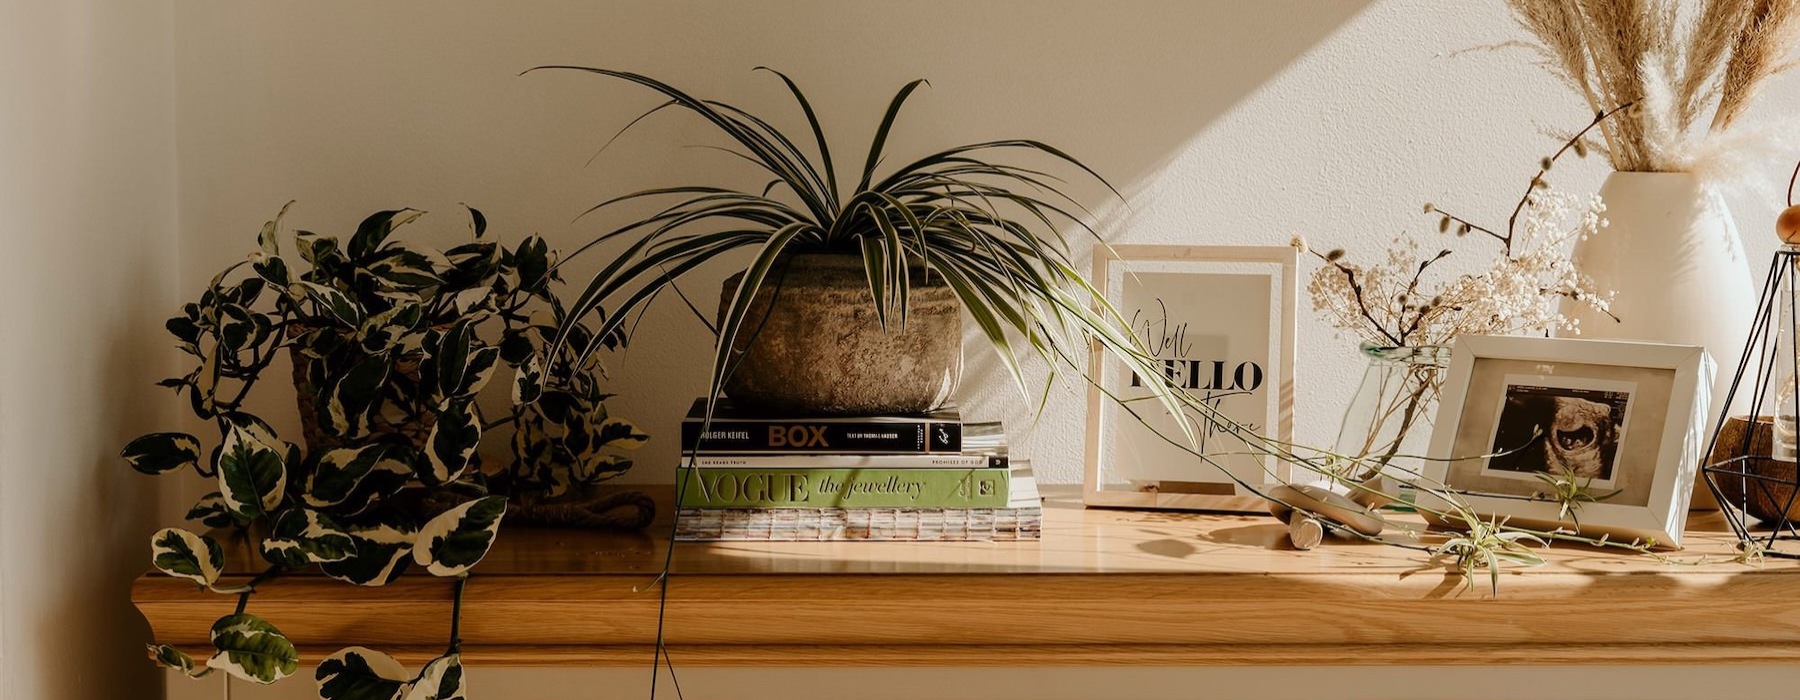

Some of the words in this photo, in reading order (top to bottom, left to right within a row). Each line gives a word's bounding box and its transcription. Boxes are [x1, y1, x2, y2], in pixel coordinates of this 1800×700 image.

[1131, 359, 1263, 391] ELLO
[727, 431, 750, 440] KEIFEL
[768, 425, 829, 447] BOX
[696, 472, 809, 504] VOGUE
[817, 475, 845, 495] the
[843, 475, 926, 500] jewellery
